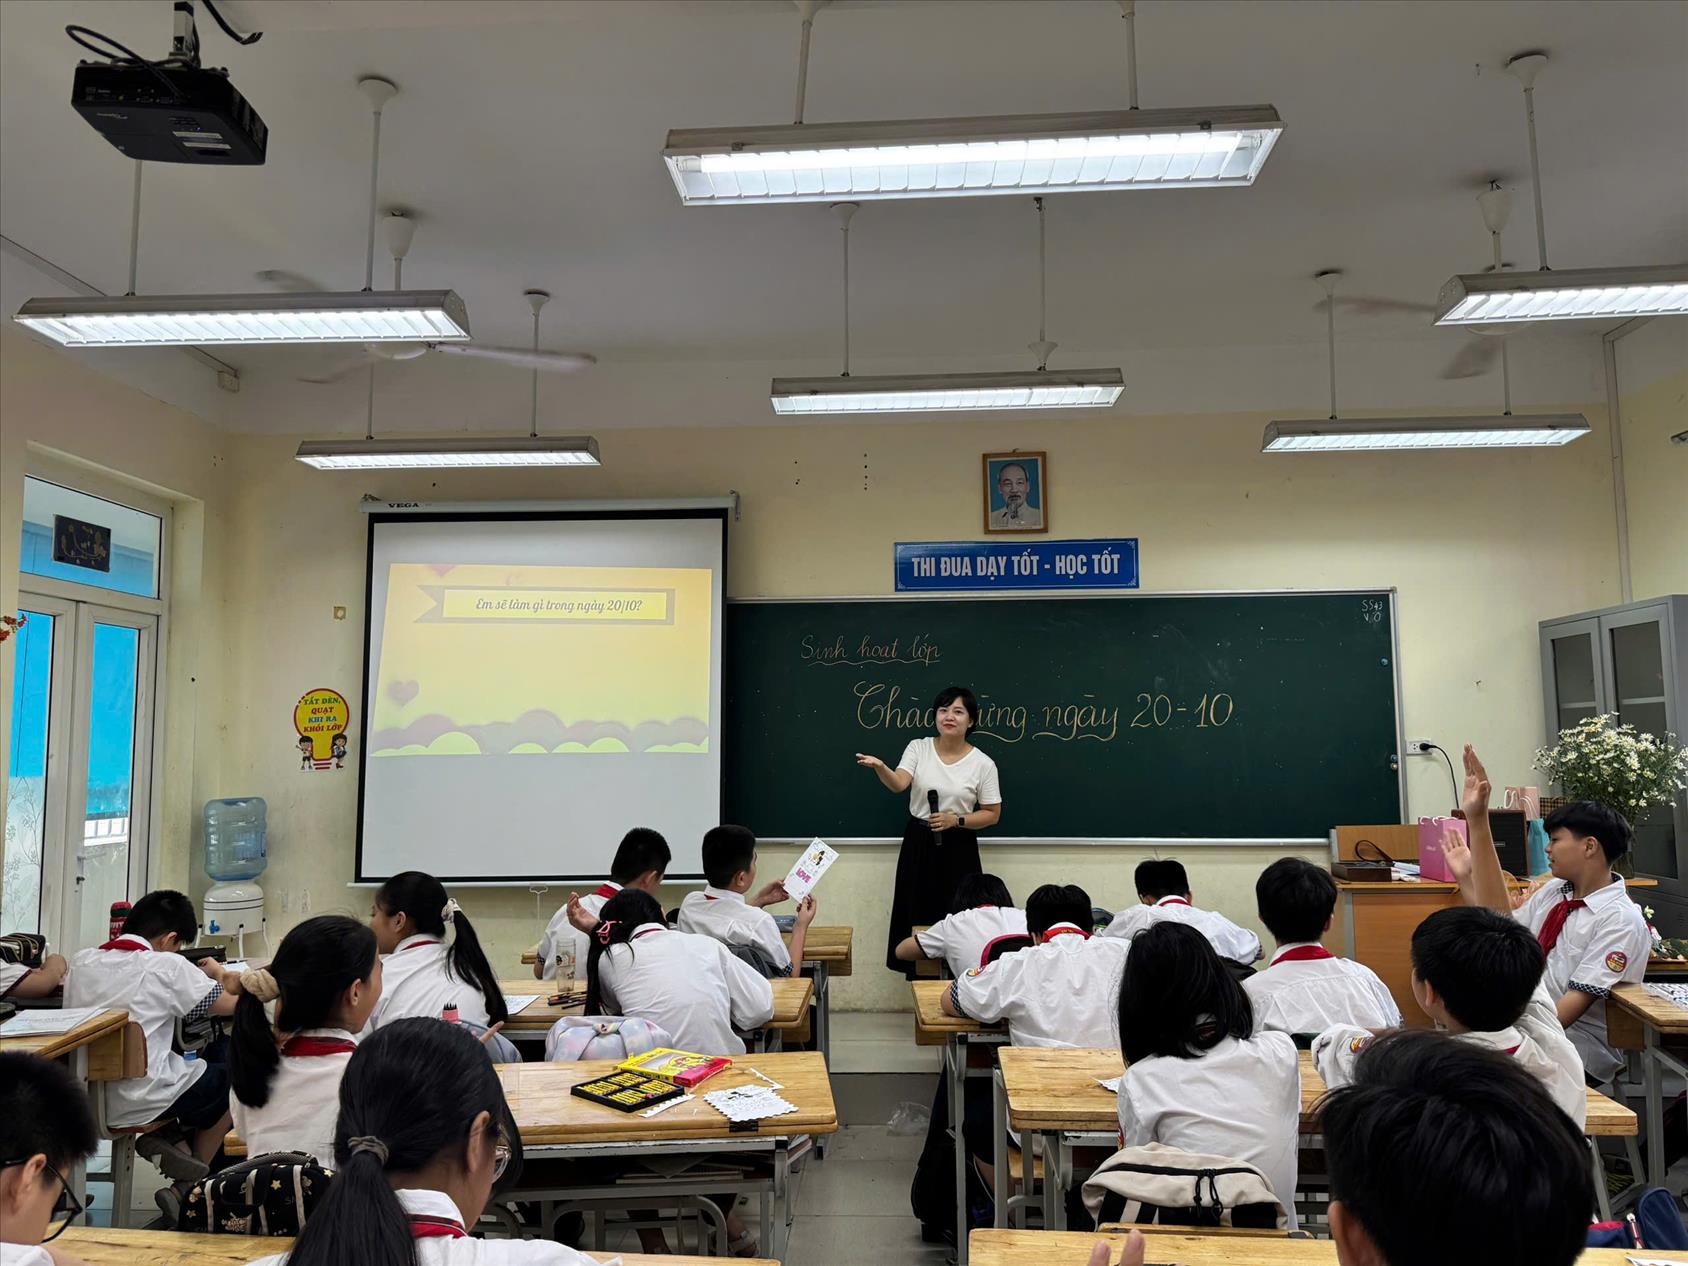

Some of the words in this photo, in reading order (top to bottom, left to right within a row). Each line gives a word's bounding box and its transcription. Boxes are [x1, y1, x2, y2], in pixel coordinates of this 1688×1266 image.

[912, 557, 936, 577] THI
[940, 556, 972, 577] ĐUA
[977, 555, 1007, 580] DẠY
[1011, 549, 1039, 576] TỐT
[1055, 554, 1087, 579] HỌC
[1092, 547, 1120, 575] TỐT
[476, 598, 493, 610] Em
[495, 599, 507, 610] sẽ
[508, 599, 530, 610] làm
[532, 599, 544, 613] gì
[546, 600, 575, 614] trong
[577, 600, 605, 614] ngày
[607, 600, 643, 614] 20/10?
[800, 634, 848, 660] Sinh
[311, 706, 334, 715] QUẠT
[973, 695, 1027, 743] ừng
[1032, 694, 1119, 742] ngày
